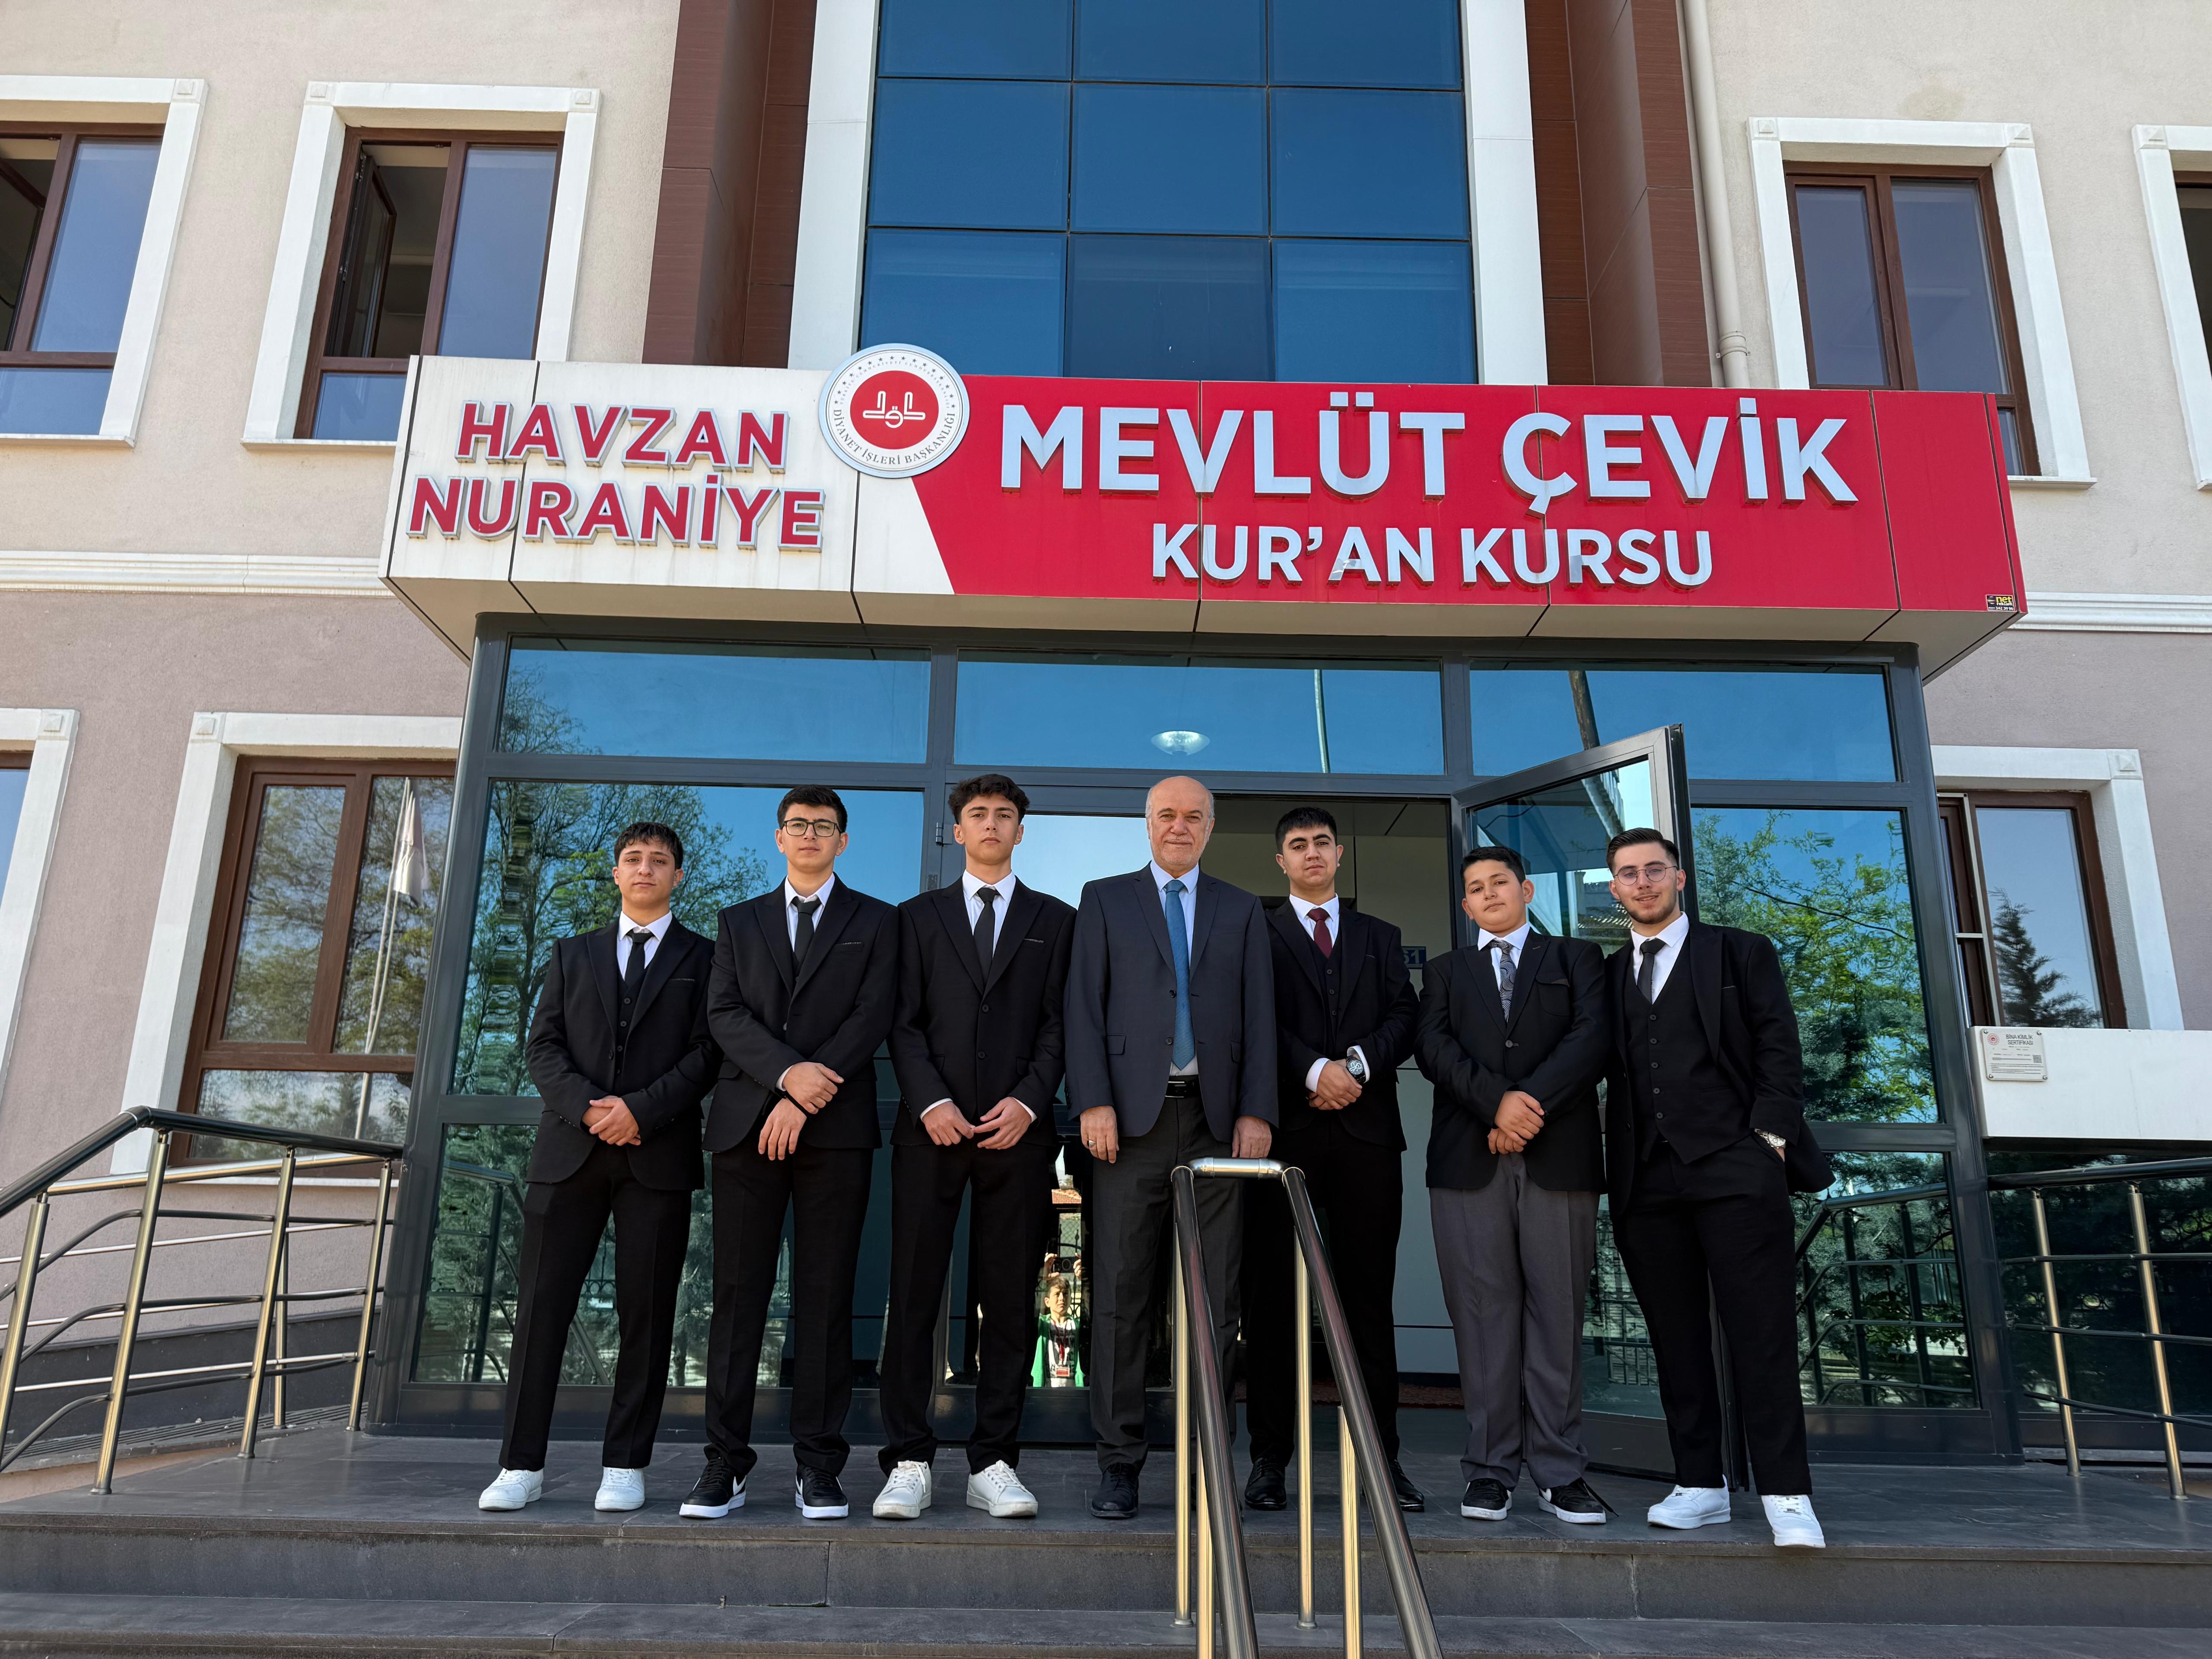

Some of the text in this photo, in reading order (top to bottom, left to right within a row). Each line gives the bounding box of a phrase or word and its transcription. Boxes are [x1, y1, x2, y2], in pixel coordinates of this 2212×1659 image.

[455, 400, 789, 474] HAVZAN
[833, 409, 955, 465] DİYANET İŞLERİ BAŞKANLIĞI
[1001, 392, 1859, 518] MEVLÜT ÇEVİK
[406, 472, 825, 552] NURANİYE
[1152, 524, 1713, 589] KUR’AN KURSU
